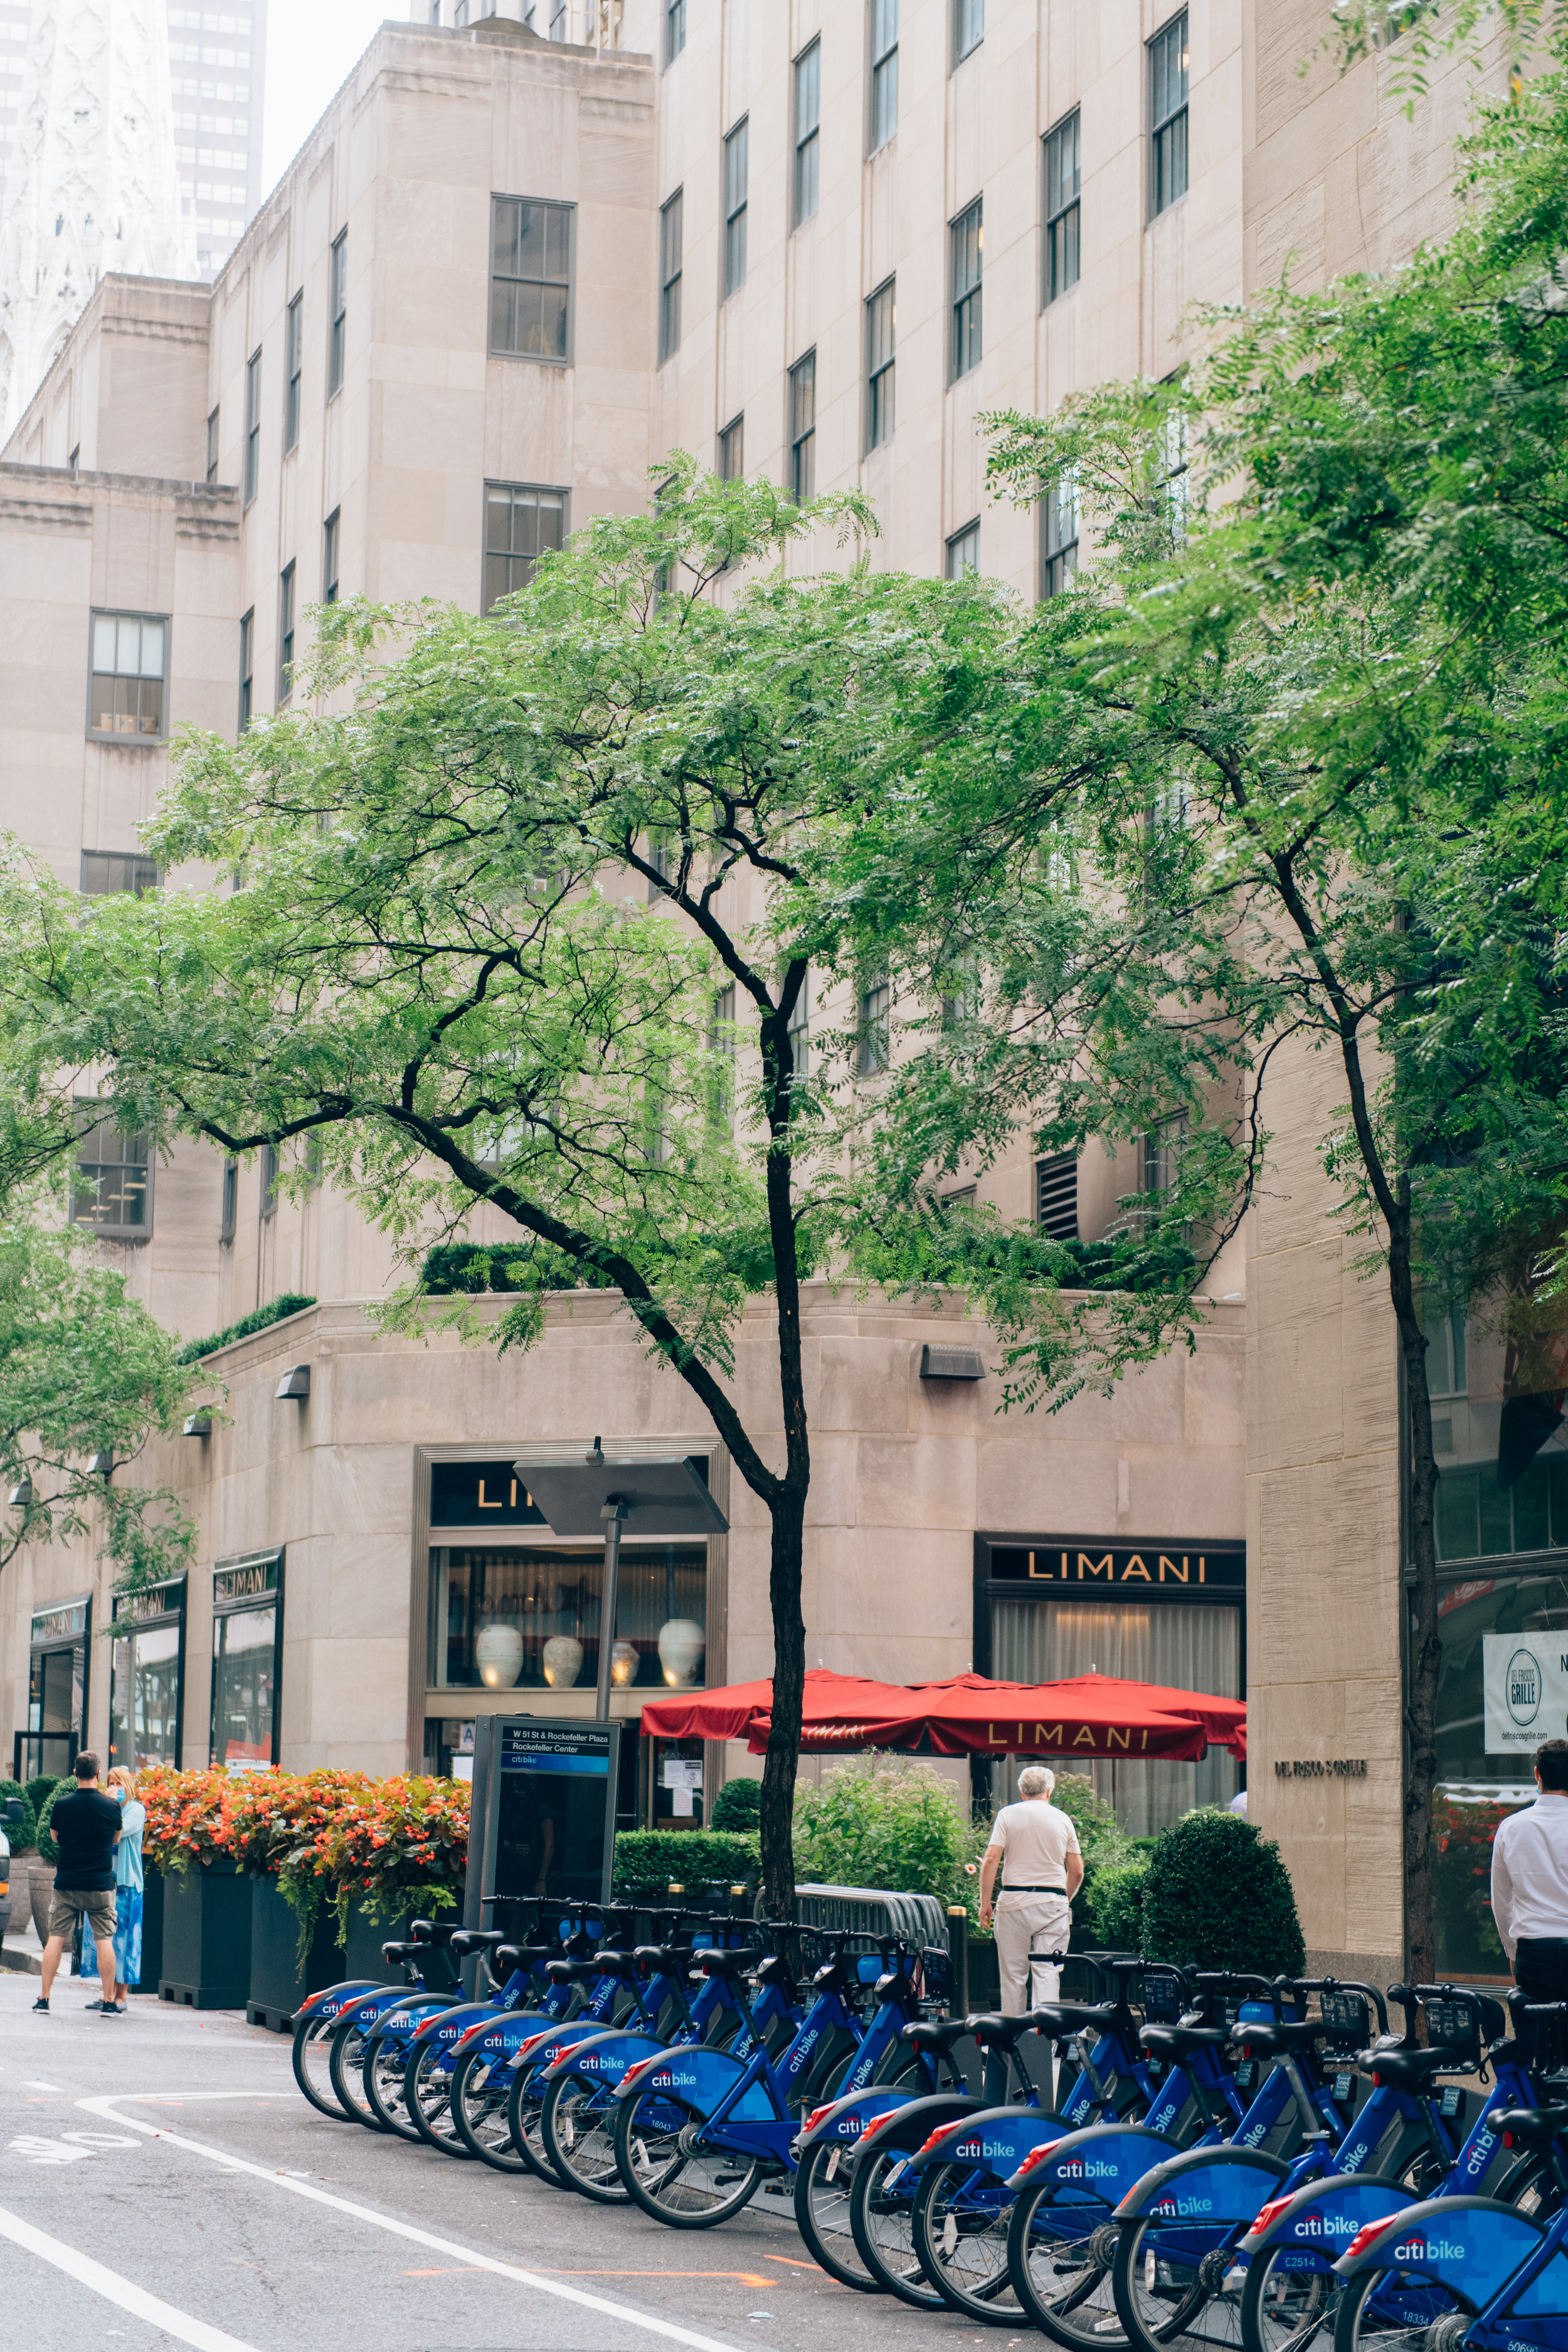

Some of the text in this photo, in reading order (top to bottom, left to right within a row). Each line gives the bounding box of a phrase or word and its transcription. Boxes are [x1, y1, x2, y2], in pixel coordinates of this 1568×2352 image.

[1029, 1551, 1205, 1583] LIMANI
[224, 1564, 267, 1599] LIMANI
[132, 1588, 166, 1619] IMANI
[1518, 1668, 1535, 1682] FRISCO'S
[1511, 1683, 1535, 1705] GRILLE
[464, 1727, 474, 1743] A
[531, 1731, 539, 1739] St
[548, 1732, 588, 1742] Rockefeller
[589, 1734, 608, 1743] Plaza
[800, 1724, 866, 1740] IMANI
[988, 1722, 1148, 1751] LIMANI
[1502, 1731, 1547, 1742] delfriscosgrille.com
[512, 1742, 578, 1753] Rockefeller Center
[1293, 1761, 1332, 1776] FRISCOS
[544, 2045, 561, 2058] cit
[651, 2119, 671, 2131] 16043
[1402, 2311, 1429, 2326] 18334
